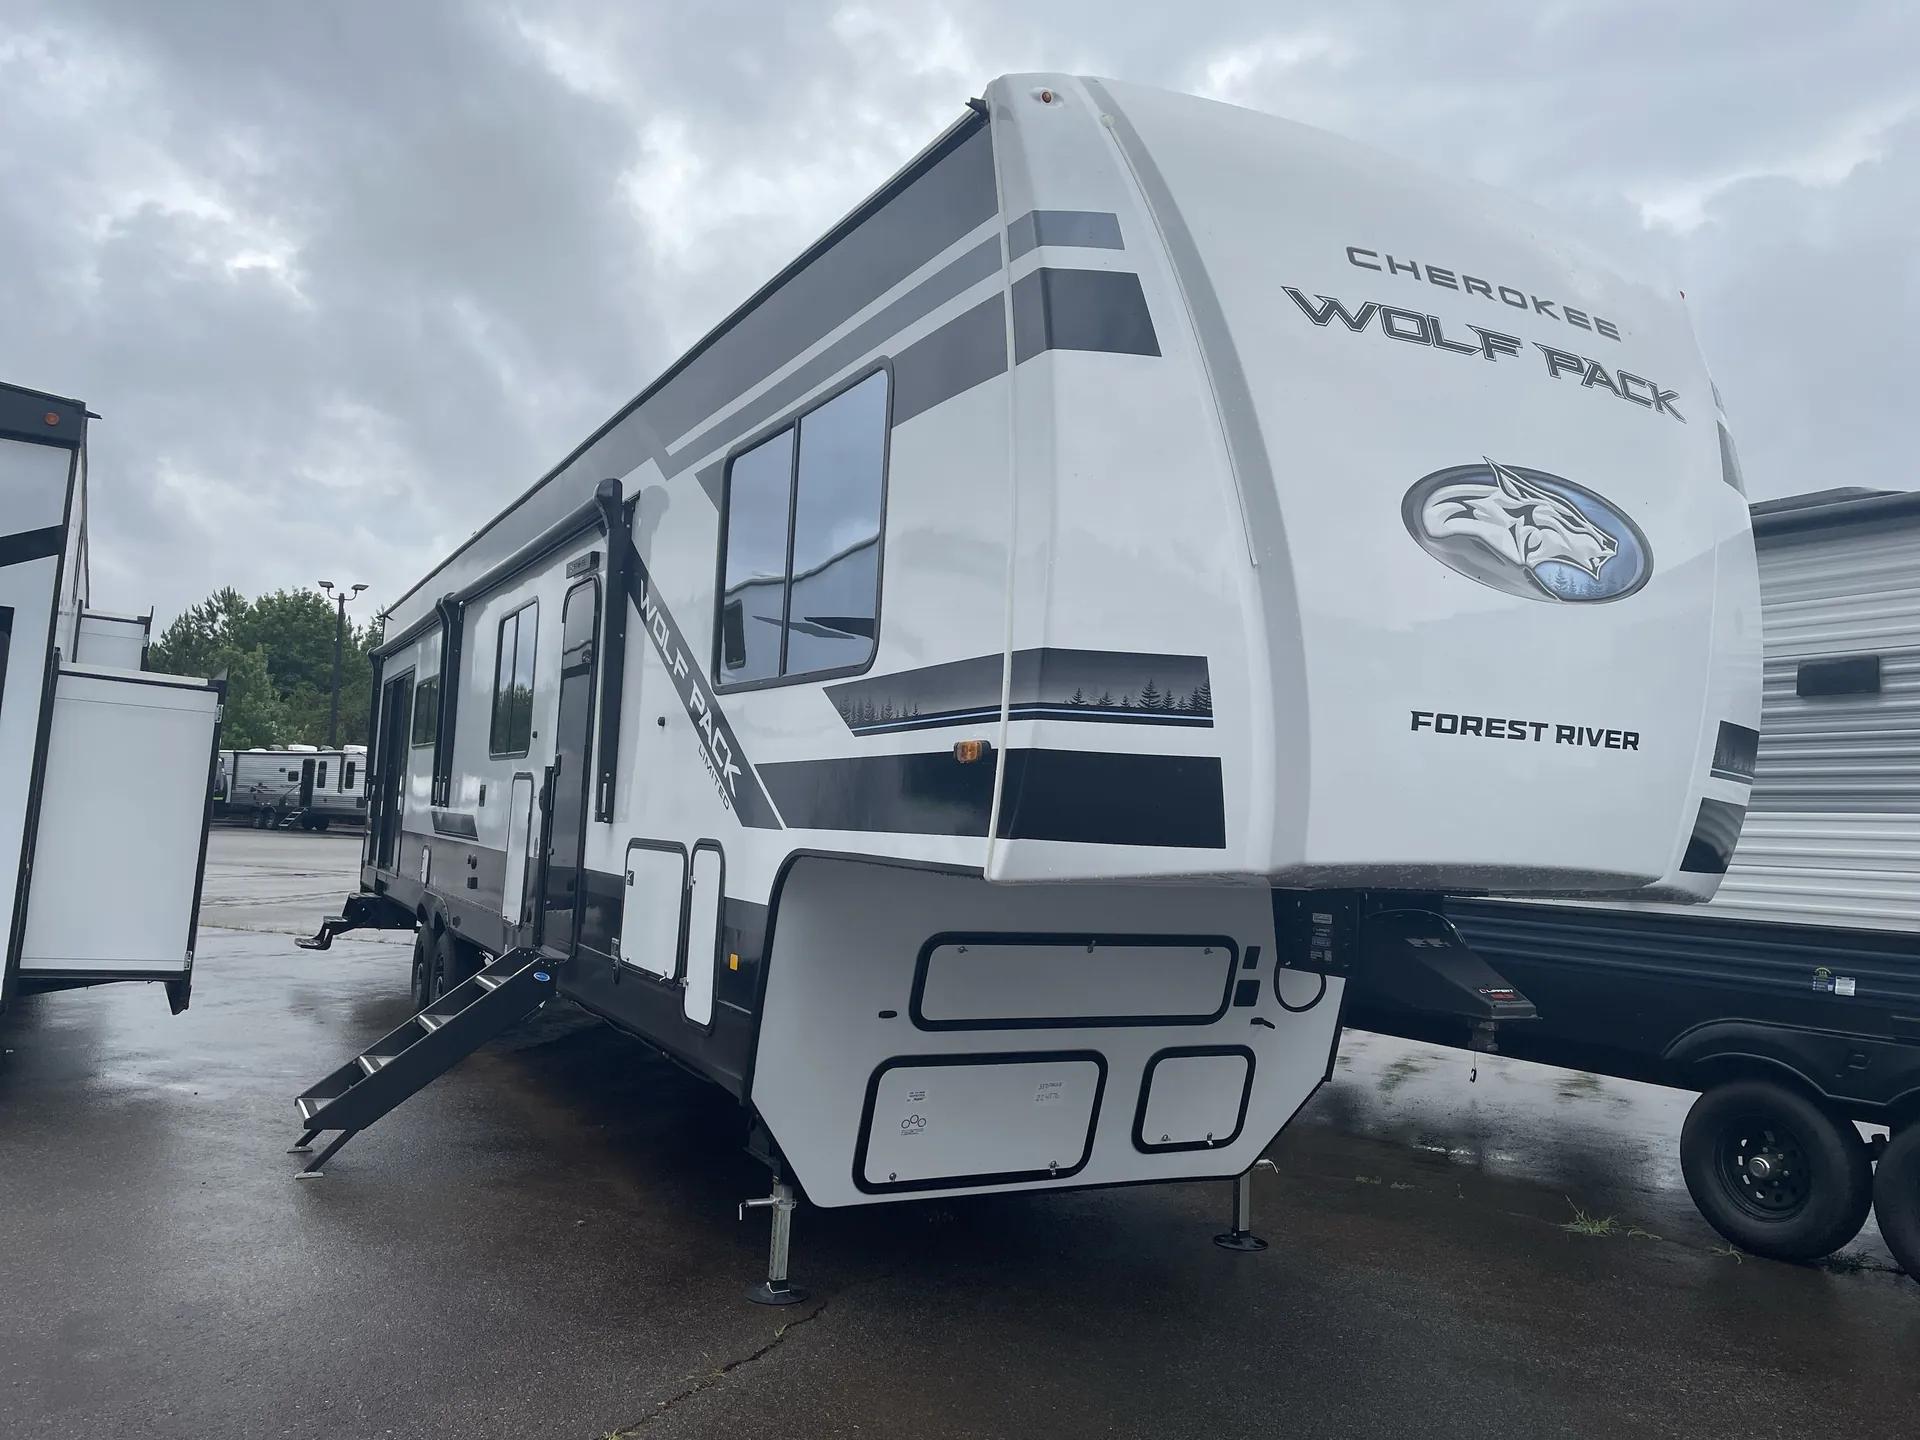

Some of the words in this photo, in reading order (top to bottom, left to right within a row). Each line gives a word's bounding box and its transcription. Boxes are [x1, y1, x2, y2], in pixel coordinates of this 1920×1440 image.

[1346, 246, 1621, 342] CHEROKEE
[1281, 285, 1523, 361] WOLF
[1532, 341, 1687, 424] PACK
[639, 579, 689, 679] WOLF
[689, 679, 742, 798] PACK
[1410, 711, 1549, 742] FOREST
[1555, 724, 1640, 750] RIVER
[698, 743, 730, 811] LIMITED
